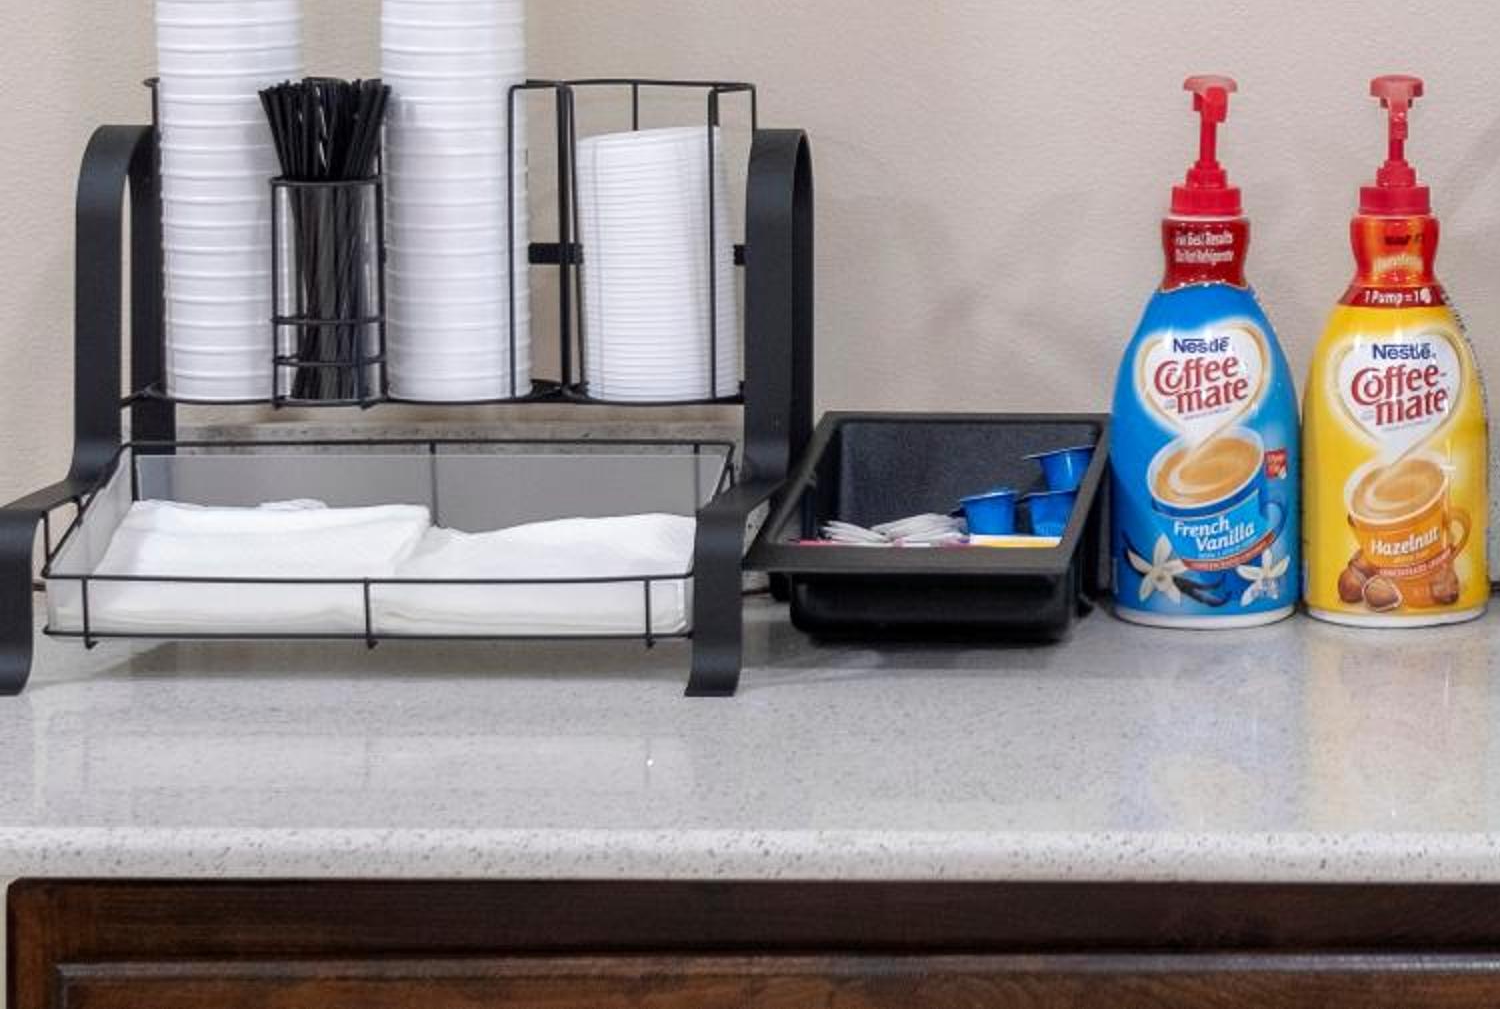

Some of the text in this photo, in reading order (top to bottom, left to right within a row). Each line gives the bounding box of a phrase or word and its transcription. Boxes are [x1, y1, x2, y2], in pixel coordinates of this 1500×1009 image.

[1372, 290, 1403, 308] Pump
[1372, 343, 1432, 360] Nestlé
[1176, 378, 1248, 414] mate
[1375, 388, 1448, 426] mate
[1173, 515, 1230, 537] French
[1196, 522, 1255, 551] Vanilla
[1371, 526, 1440, 556] Hazelnut
